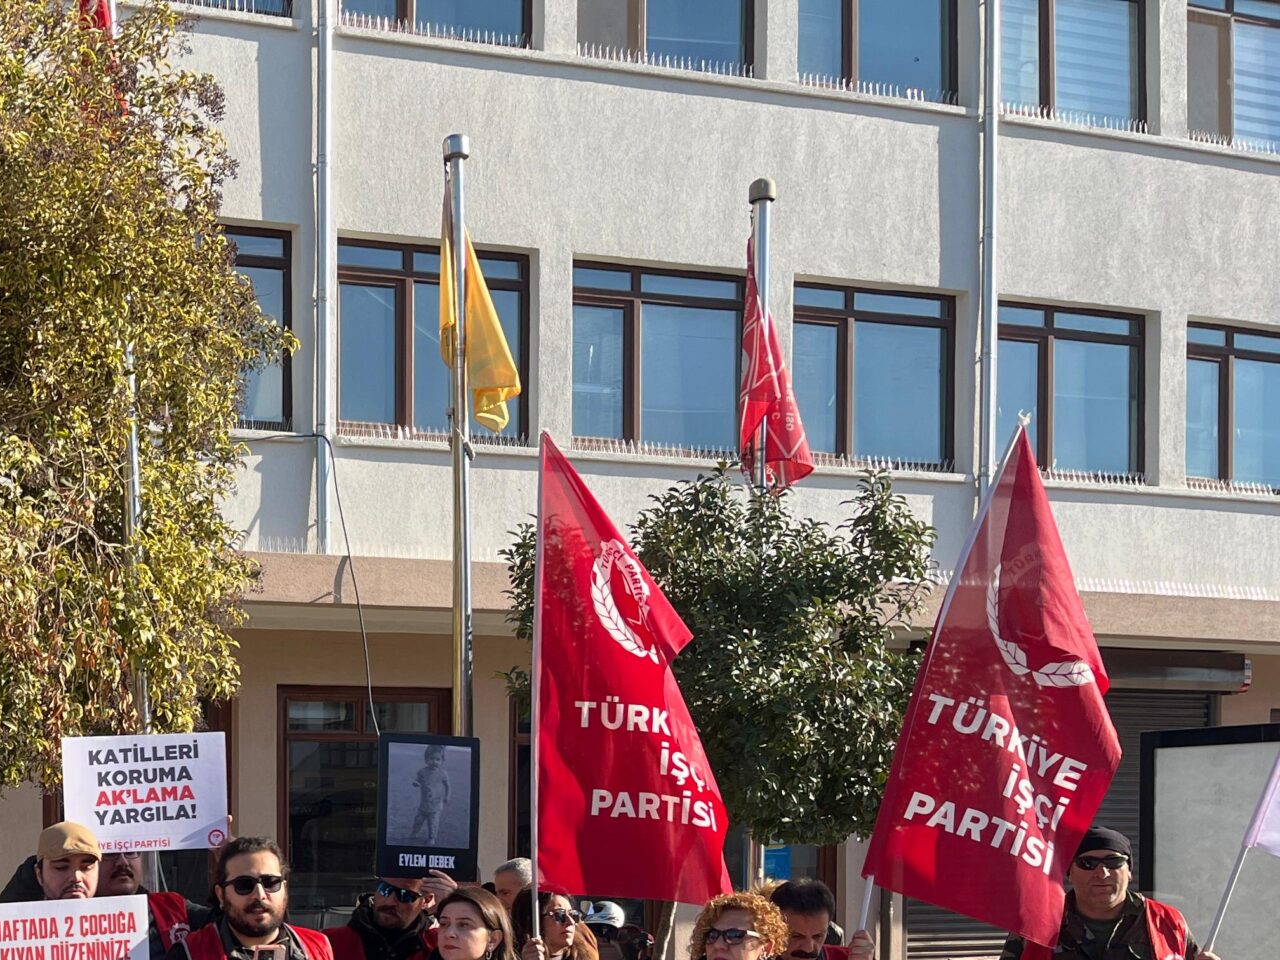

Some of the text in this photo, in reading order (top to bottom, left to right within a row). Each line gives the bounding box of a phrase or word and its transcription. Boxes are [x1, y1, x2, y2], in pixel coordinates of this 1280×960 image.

[88, 740, 199, 766] KATİLLERİ
[927, 693, 1088, 792] TÜRKİYE
[97, 766, 193, 787] KORUMA
[96, 785, 195, 807] AK'LAMA
[1002, 763, 1071, 832] İŞÇİ
[94, 804, 197, 826] YARGILA!
[590, 789, 717, 832] PARTİSİ
[114, 839, 133, 851] İŞÇİ
[134, 837, 170, 849] PARTİSİ
[903, 791, 1055, 876] PARTİSİ
[399, 853, 455, 869] EYLEM DEBEK
[64, 916, 74, 938] 2
[79, 911, 137, 938] ÇOCUĞA
